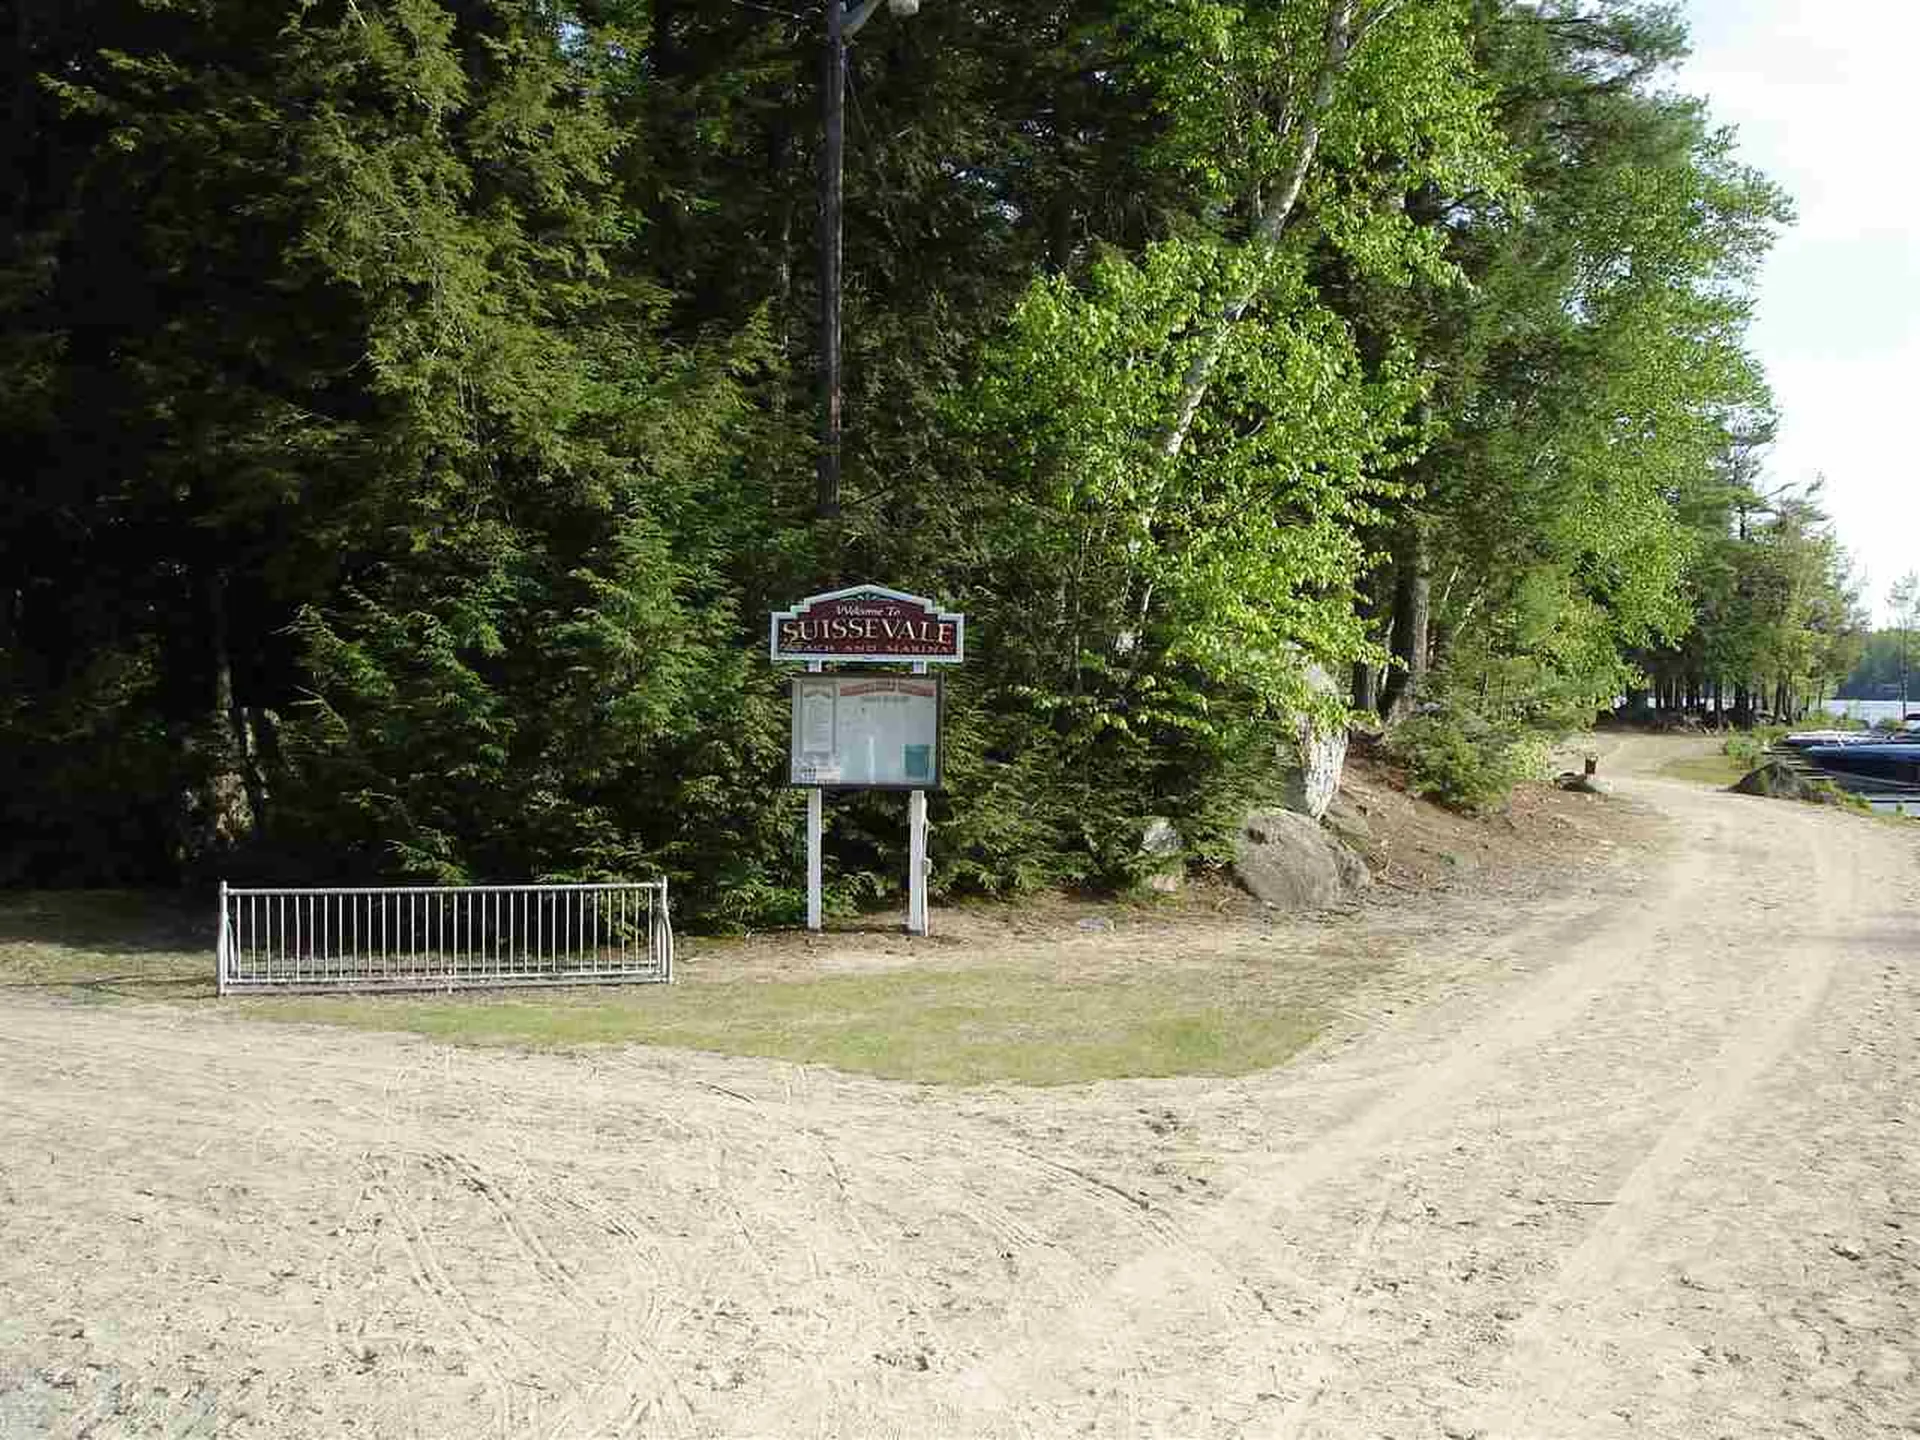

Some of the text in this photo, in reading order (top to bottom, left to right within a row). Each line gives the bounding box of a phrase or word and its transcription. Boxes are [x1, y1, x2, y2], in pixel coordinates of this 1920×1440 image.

[836, 604, 901, 617] Welcome To
[783, 617, 953, 645] SUISSEVALE
